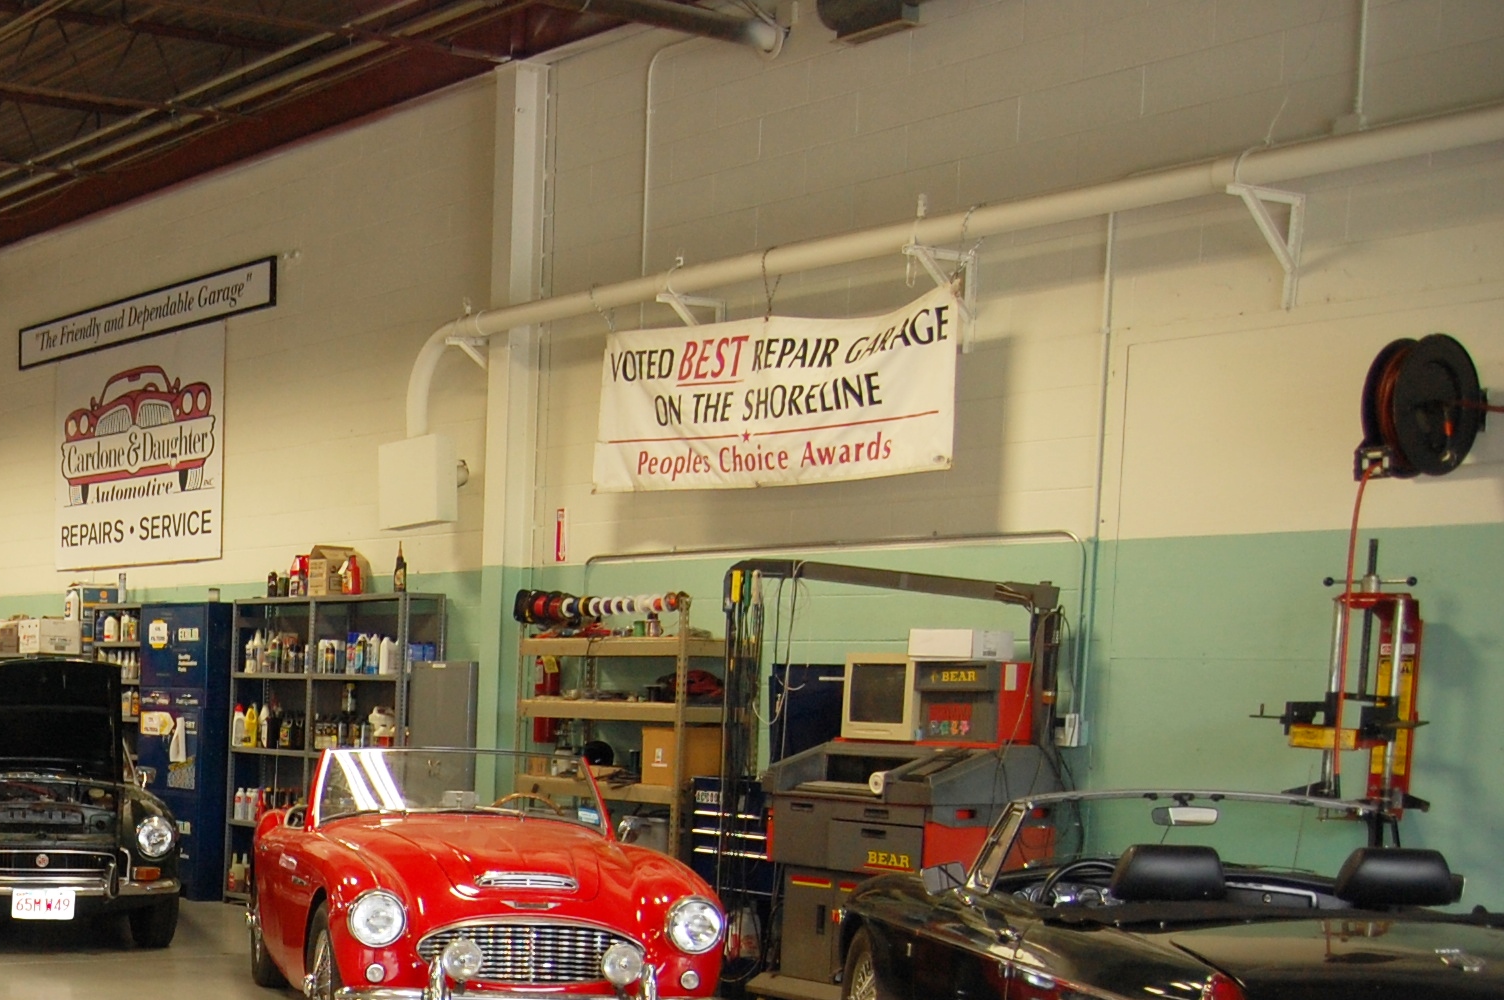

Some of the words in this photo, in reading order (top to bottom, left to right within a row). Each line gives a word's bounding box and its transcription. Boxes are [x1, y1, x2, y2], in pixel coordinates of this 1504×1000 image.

[59, 317, 101, 347] Friendly
[104, 309, 125, 332] and
[128, 291, 194, 330] Dependable
[610, 348, 675, 382] VOTED
[677, 335, 750, 382] BEST
[752, 337, 839, 372] REPAIR
[844, 305, 949, 365] GARAGE
[653, 393, 682, 427] ON
[692, 391, 734, 424] THE
[742, 371, 883, 422] SHORELINE
[66, 441, 125, 475] Cardone
[126, 431, 141, 468] &
[142, 425, 209, 463] Daughter
[636, 447, 712, 482] Peoples
[719, 445, 789, 473] Choice
[800, 431, 893, 468] Awards
[91, 478, 174, 505] Automotive
[61, 519, 125, 548] REPAIRS
[139, 509, 212, 541] SERVICE
[941, 670, 978, 683] BEAR
[867, 851, 911, 869] BEAR
